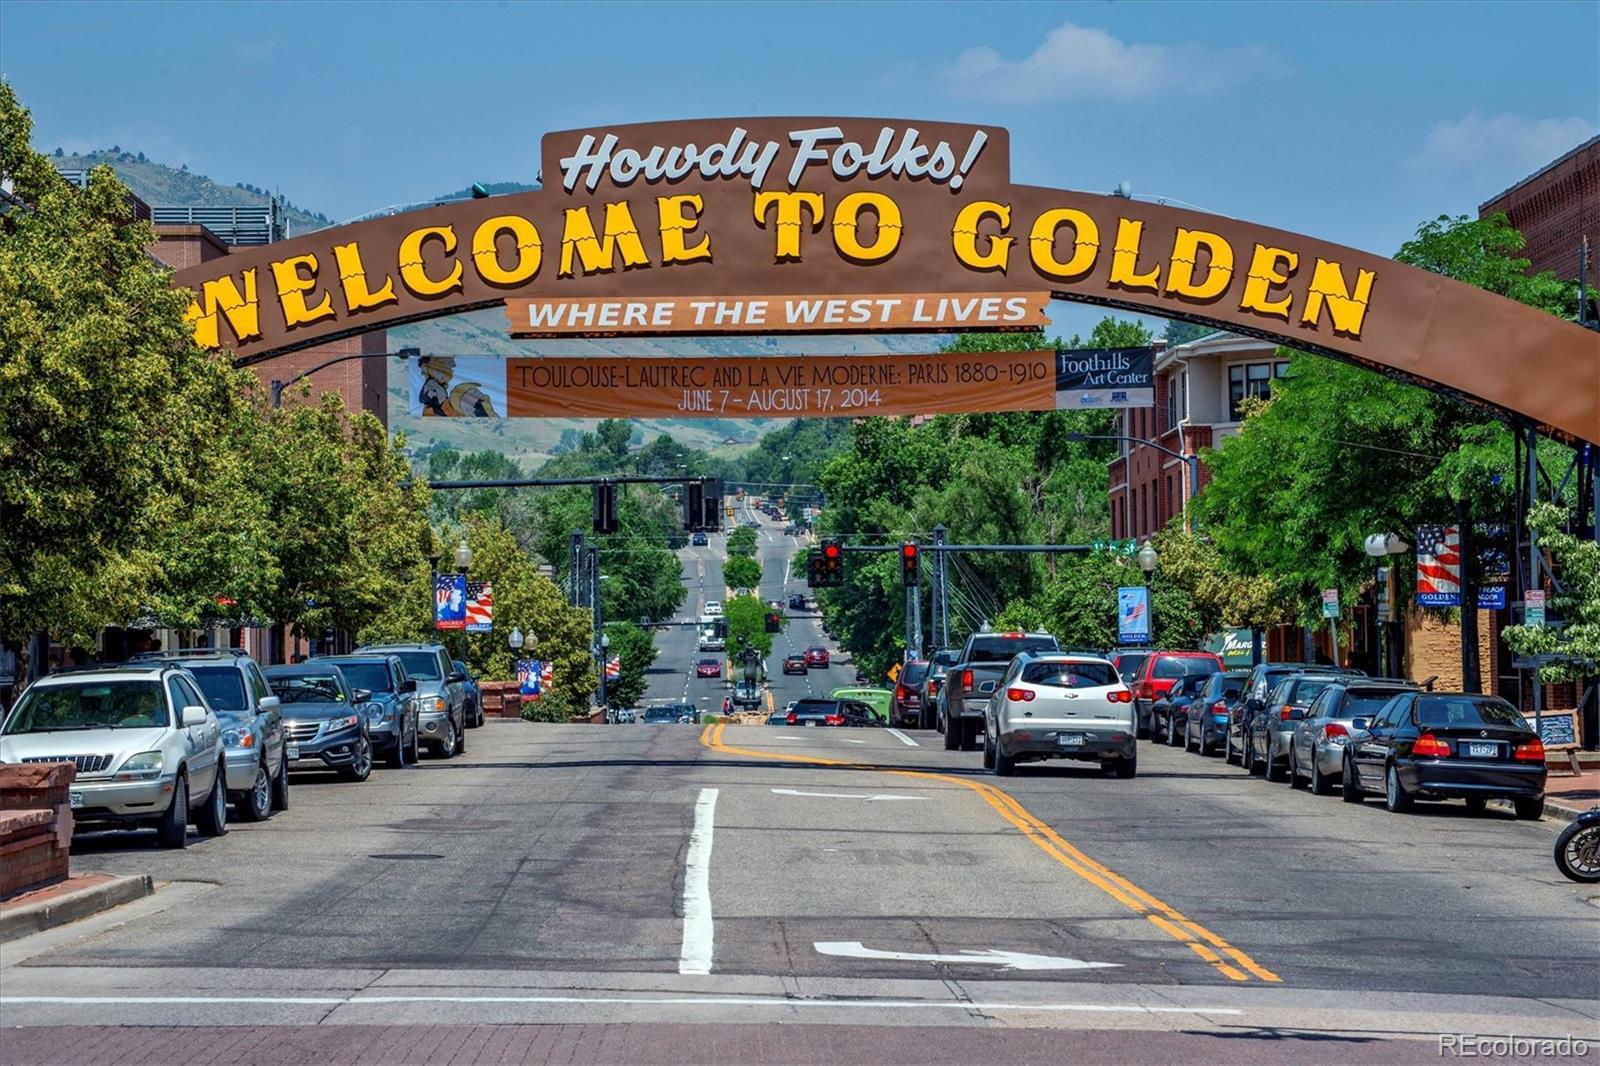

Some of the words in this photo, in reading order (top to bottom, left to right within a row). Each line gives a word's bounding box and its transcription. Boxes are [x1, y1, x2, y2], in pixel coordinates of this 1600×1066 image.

[559, 127, 780, 191] Howdy
[786, 127, 989, 190] Folks!
[184, 194, 713, 348] WELCOME
[753, 190, 904, 264] TO
[951, 200, 1377, 339] GOLDEN
[528, 302, 673, 328] WHERE
[689, 301, 767, 325] THE
[785, 299, 901, 324] WEST
[912, 298, 1027, 322] LIVES
[515, 366, 707, 388] TOULOUSE-LAUTREC
[713, 366, 742, 386] AND
[748, 366, 769, 386] LA
[776, 365, 805, 386] VIE
[812, 364, 901, 386] MODERNE:
[909, 364, 948, 384] PARIS
[955, 362, 1047, 385] 1880-1910
[1061, 352, 1130, 373] Foothills
[1082, 371, 1105, 385] Art
[1107, 371, 1148, 384] Center
[678, 390, 714, 411] JUNE
[720, 390, 729, 413] 7
[747, 389, 810, 411] AUGUST
[816, 389, 834, 411] 17,
[841, 388, 882, 408] 2014
